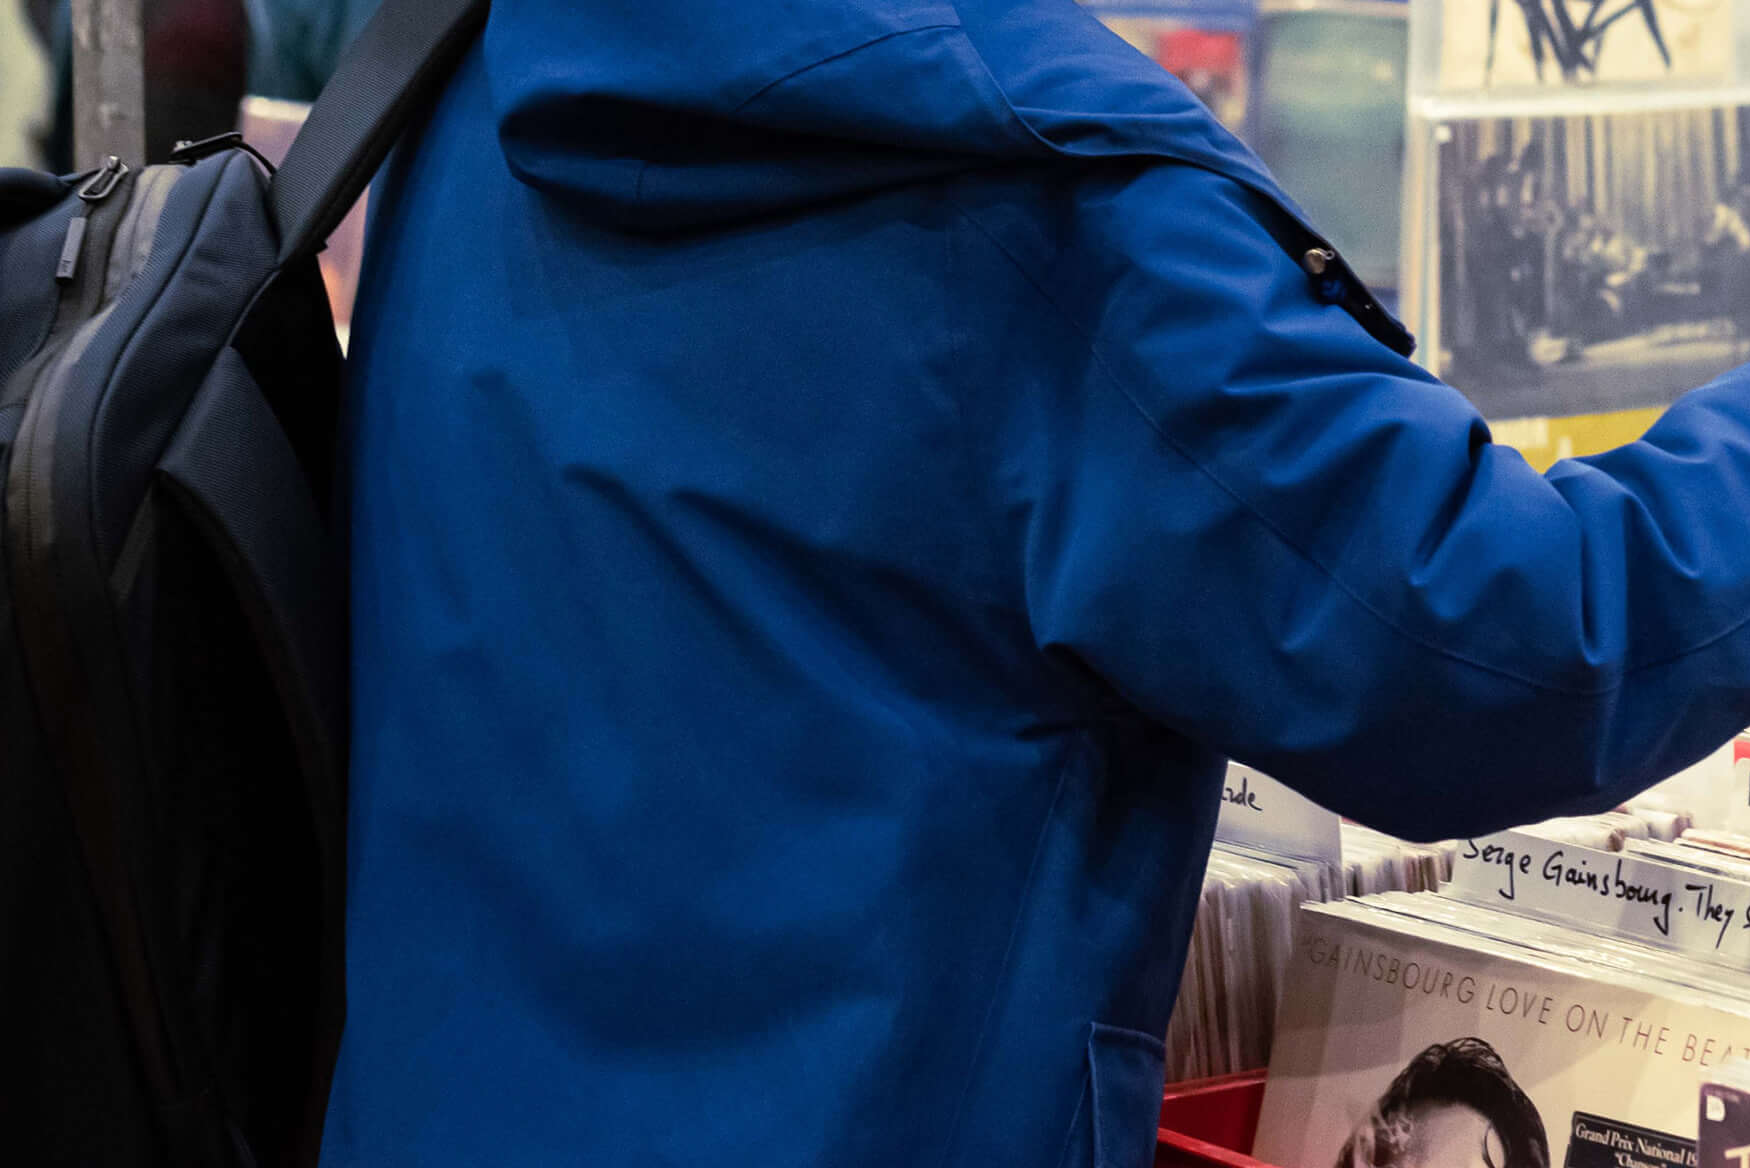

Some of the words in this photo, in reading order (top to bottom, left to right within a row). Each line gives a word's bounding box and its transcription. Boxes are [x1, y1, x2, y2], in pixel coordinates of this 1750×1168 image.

[1461, 838, 1532, 901] Serge
[1685, 884, 1734, 948] They
[1486, 981, 1553, 1026] LOVE
[1565, 1002, 1609, 1040] ON
[1618, 1014, 1671, 1056] THE
[1575, 1122, 1610, 1145] Grand
[1610, 1130, 1634, 1152] Prix
[1635, 1137, 1686, 1165] National
